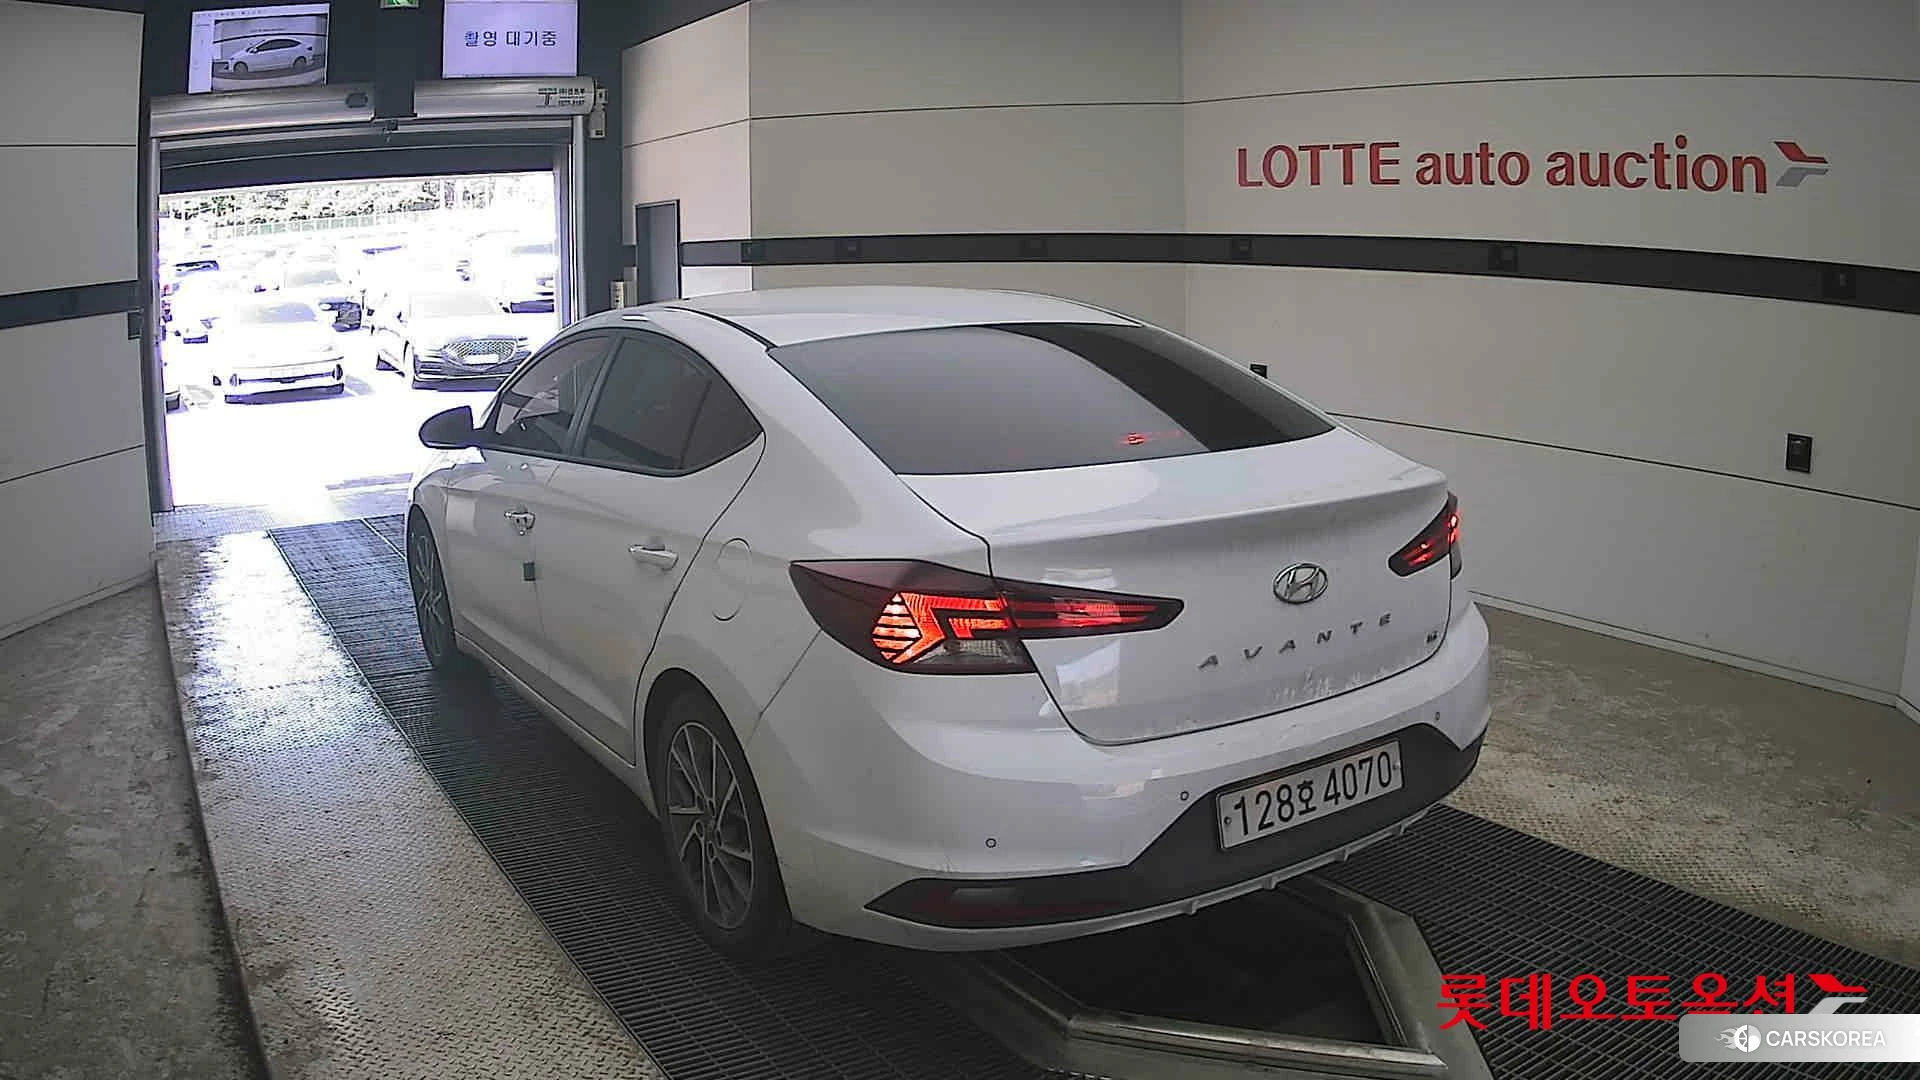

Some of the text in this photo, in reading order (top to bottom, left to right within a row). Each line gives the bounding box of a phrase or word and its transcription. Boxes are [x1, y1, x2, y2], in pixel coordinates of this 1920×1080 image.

[506, 30, 557, 47] 대기중
[1237, 134, 1767, 194] LOTTE auto auction
[1199, 613, 1391, 669] AVANTE
